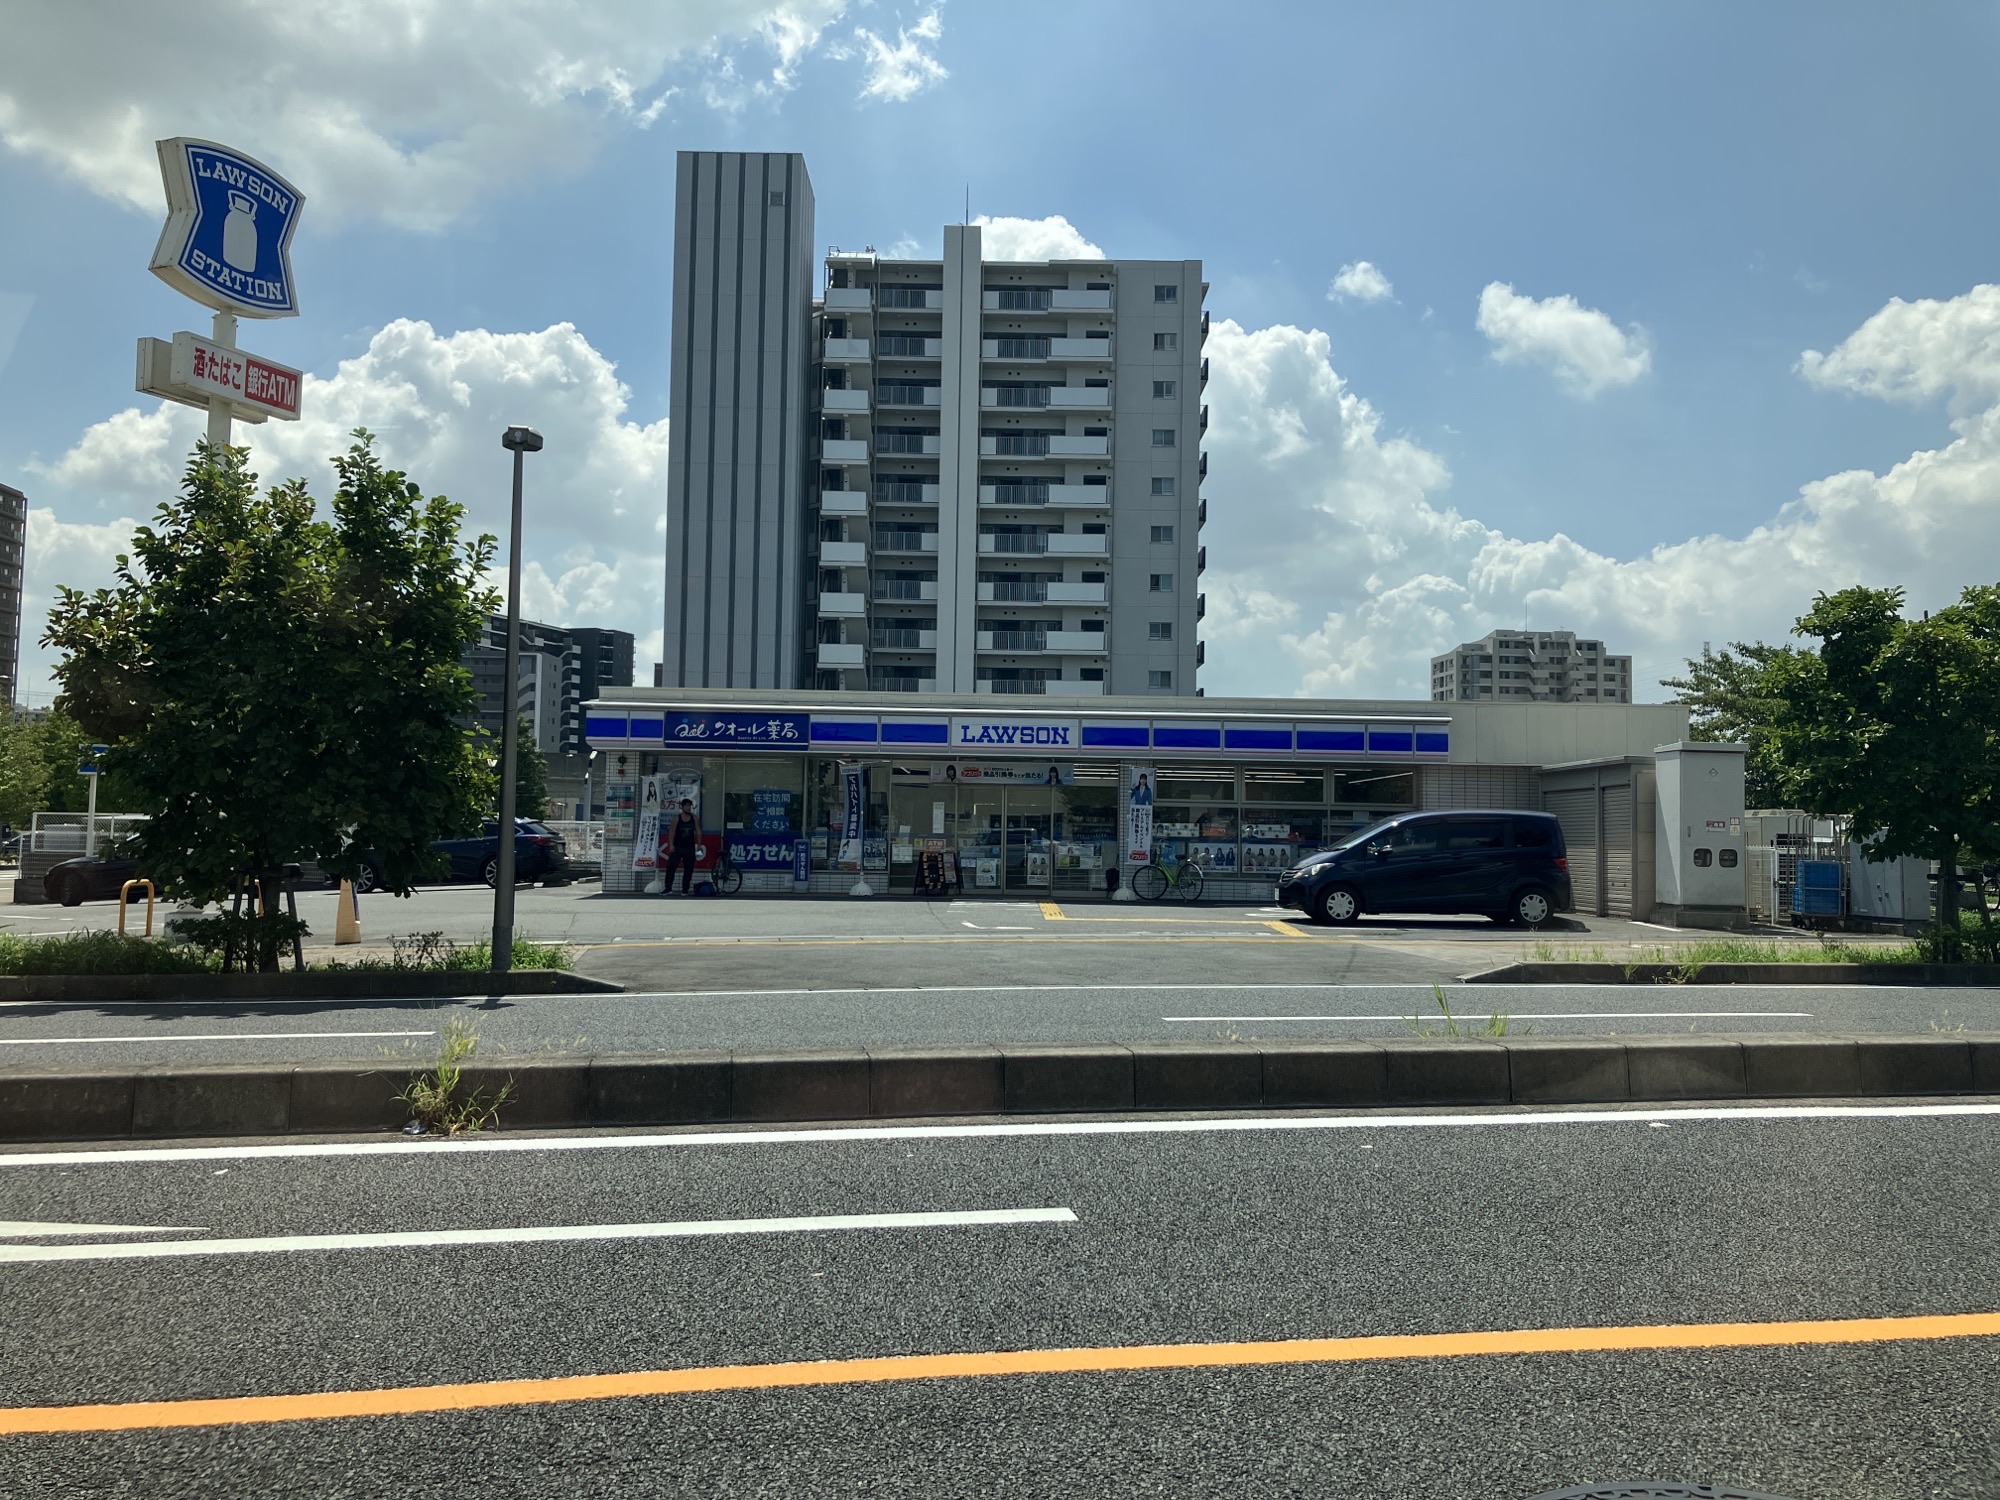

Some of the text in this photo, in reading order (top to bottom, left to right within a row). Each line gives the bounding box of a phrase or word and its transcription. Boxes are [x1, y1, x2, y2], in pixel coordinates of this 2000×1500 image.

[196, 158, 288, 215] LAWSON
[191, 249, 283, 300] STATION
[247, 365, 295, 407] 銀行ATM
[714, 720, 798, 740] クオール薬局
[961, 725, 1069, 744] LAWSON
[753, 793, 791, 803] 在宅訪問
[758, 806, 786, 816] ご相談
[754, 820, 790, 830] ください
[730, 844, 794, 863] 処方せん
